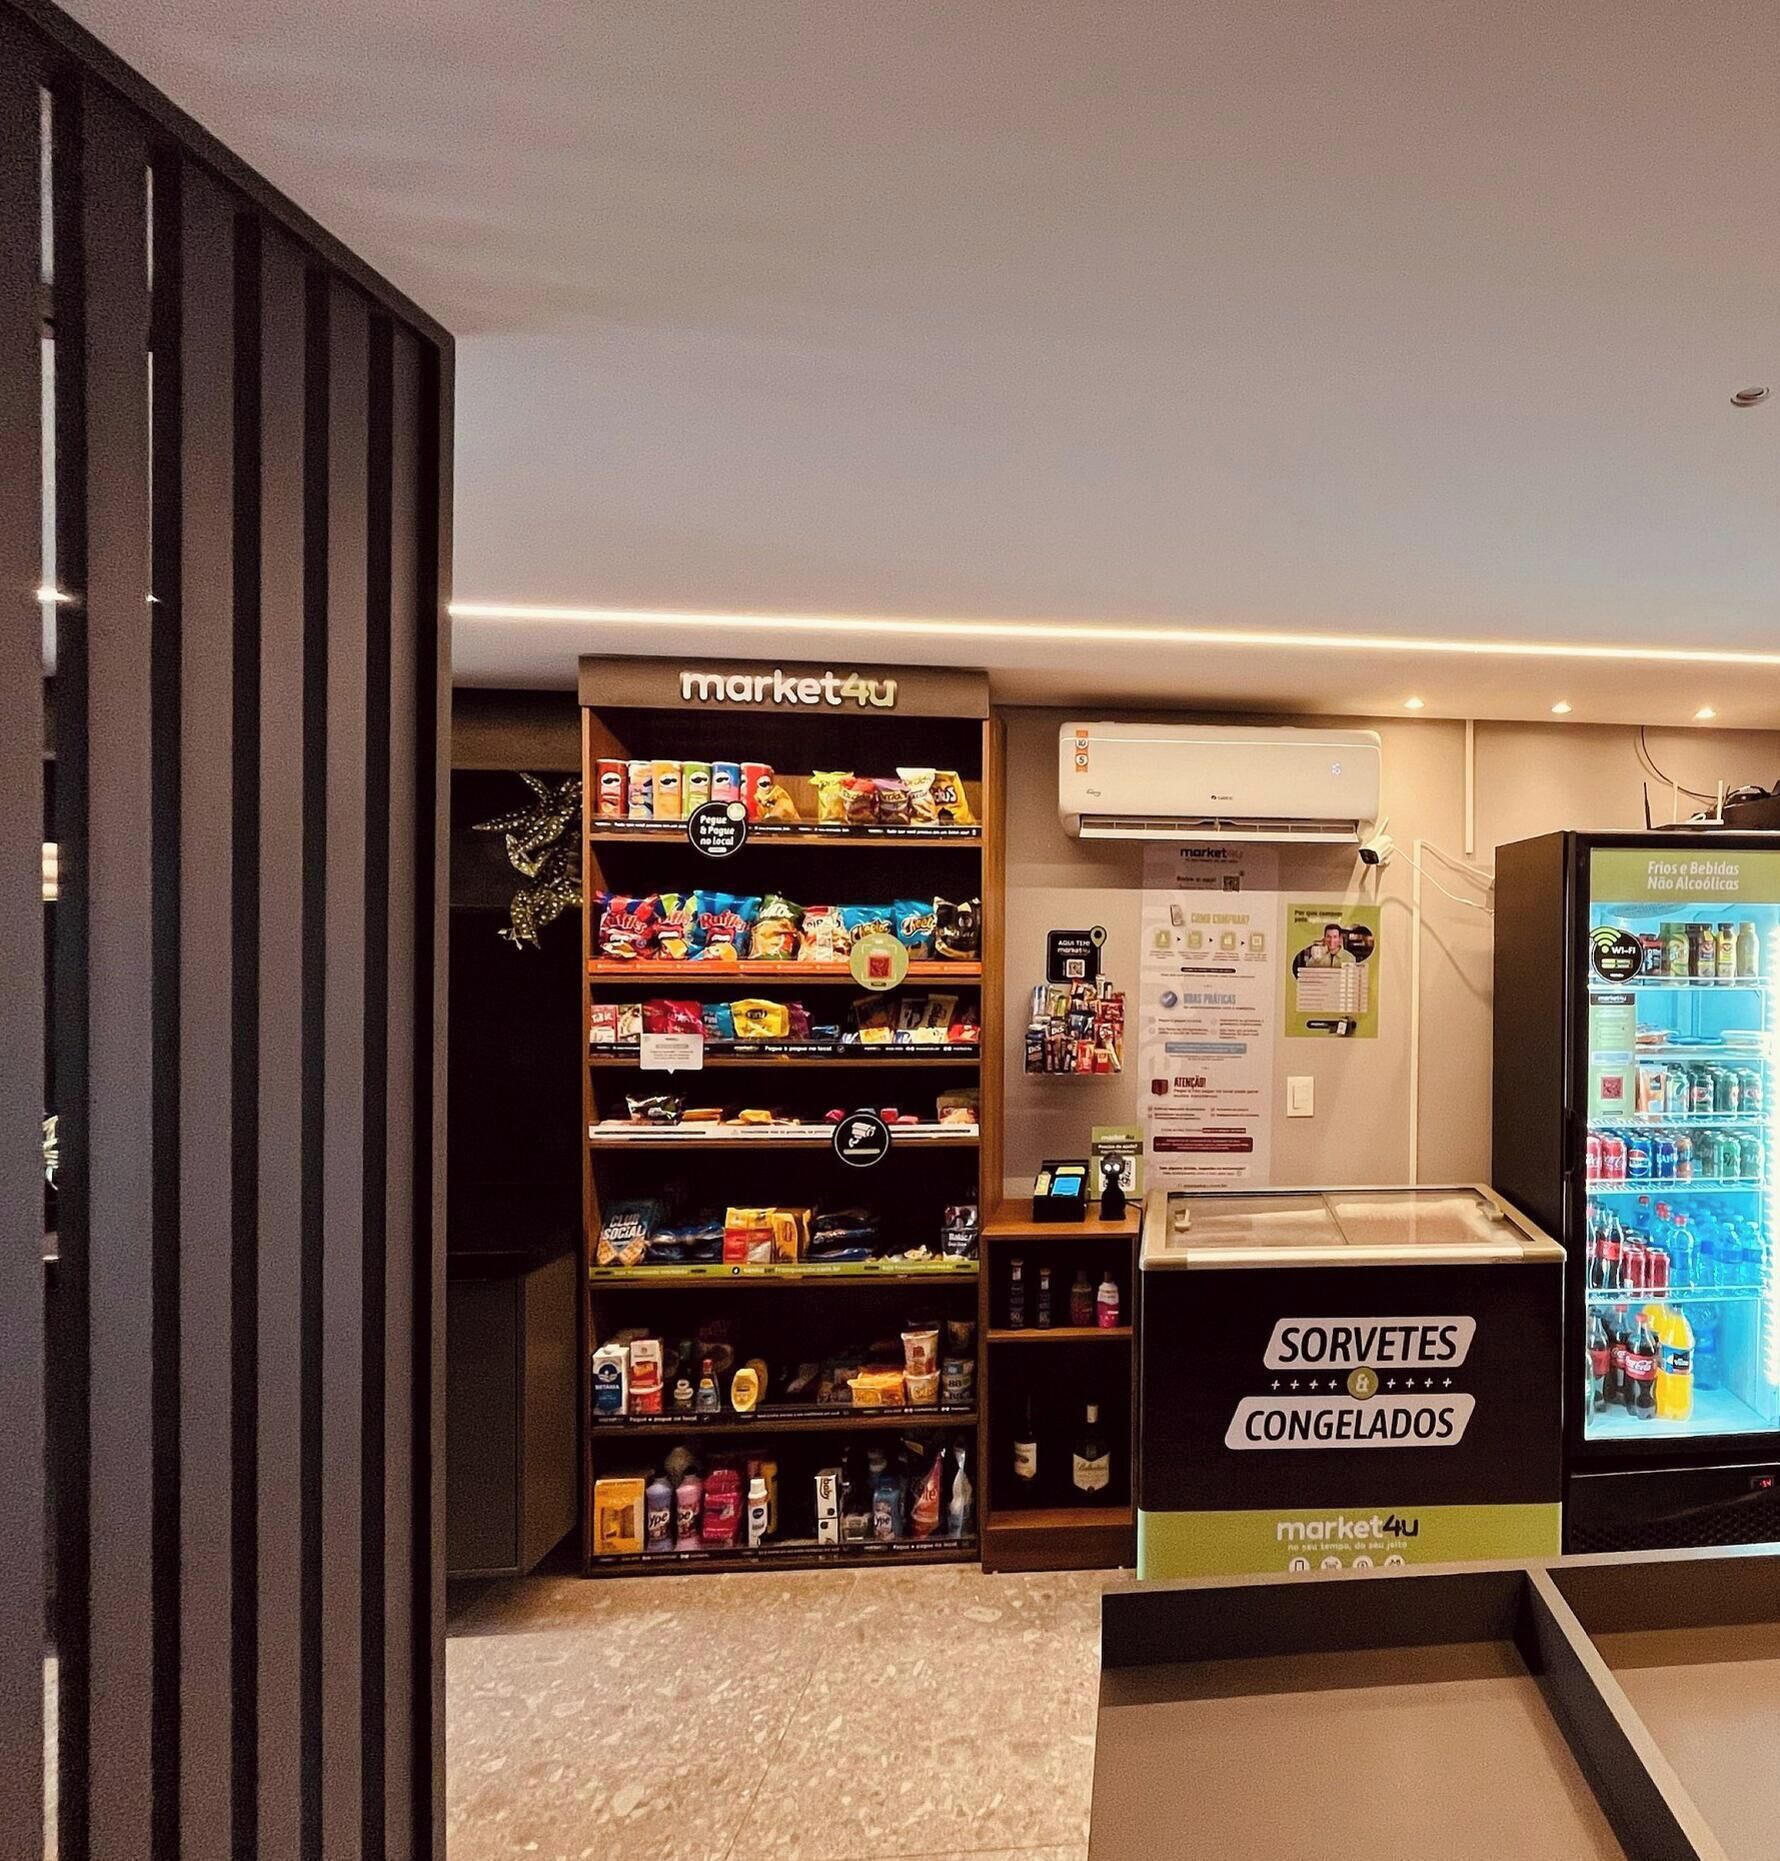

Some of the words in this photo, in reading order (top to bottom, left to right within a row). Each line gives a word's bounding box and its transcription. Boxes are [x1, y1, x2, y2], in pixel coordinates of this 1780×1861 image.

[680, 668, 898, 707] market4u
[700, 815, 727, 825] Pegue
[712, 836, 734, 846] local
[1648, 860, 1677, 876] Frios
[1680, 864, 1688, 875] e
[1690, 860, 1739, 876] Bebidas
[1648, 875, 1672, 890] Não
[1675, 875, 1739, 891] Alcoólicas
[609, 1213, 640, 1227] CLUB
[604, 1225, 646, 1241] SOCIAL
[1278, 1325, 1458, 1364] SORVETES
[1245, 1407, 1455, 1441] CONGELADOS
[1277, 1514, 1419, 1541] market4u
[1288, 1543, 1299, 1551] no
[1302, 1543, 1317, 1551] seu
[1368, 1541, 1384, 1549] seu
[1386, 1540, 1408, 1551] jeito
